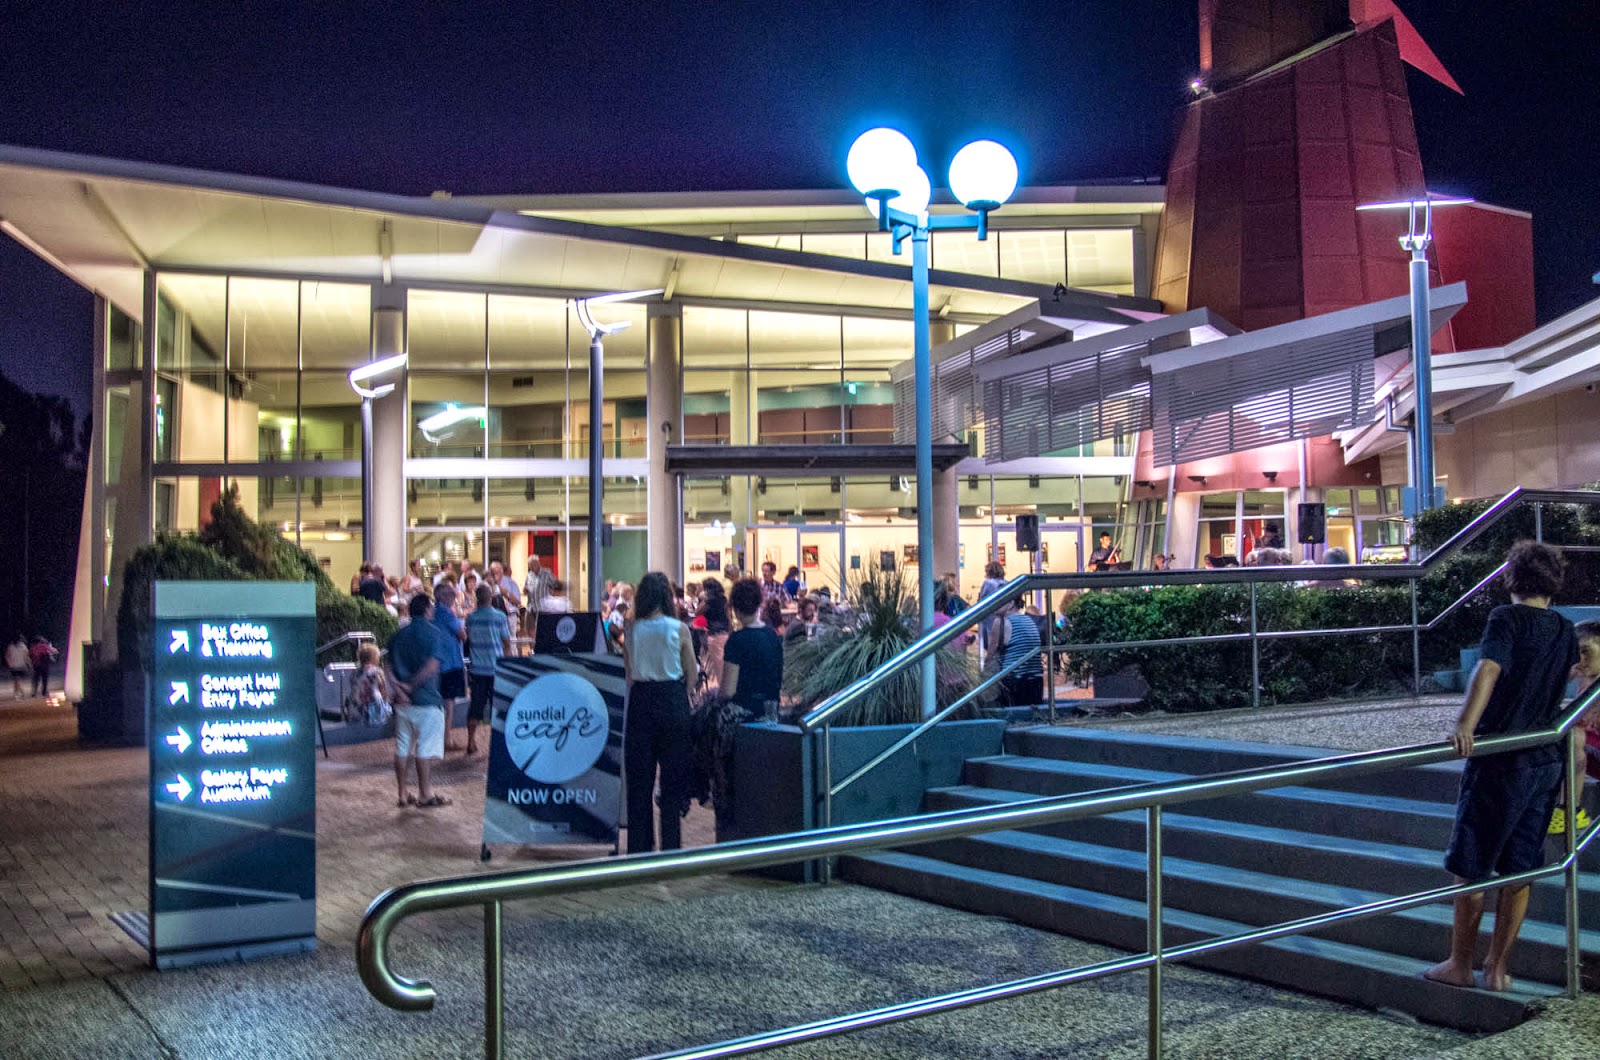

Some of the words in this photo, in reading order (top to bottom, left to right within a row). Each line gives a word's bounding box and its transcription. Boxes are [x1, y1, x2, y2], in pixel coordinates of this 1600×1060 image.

[229, 622, 270, 641] Office
[201, 673, 254, 692] Concert
[254, 672, 282, 691] Hall
[201, 690, 237, 710] Entry
[517, 705, 565, 721] sundial
[200, 718, 293, 738] Administration
[200, 737, 249, 755] Offices
[200, 785, 271, 804] Auditorium
[507, 787, 549, 805] NOW
[552, 788, 597, 805] OPEN
